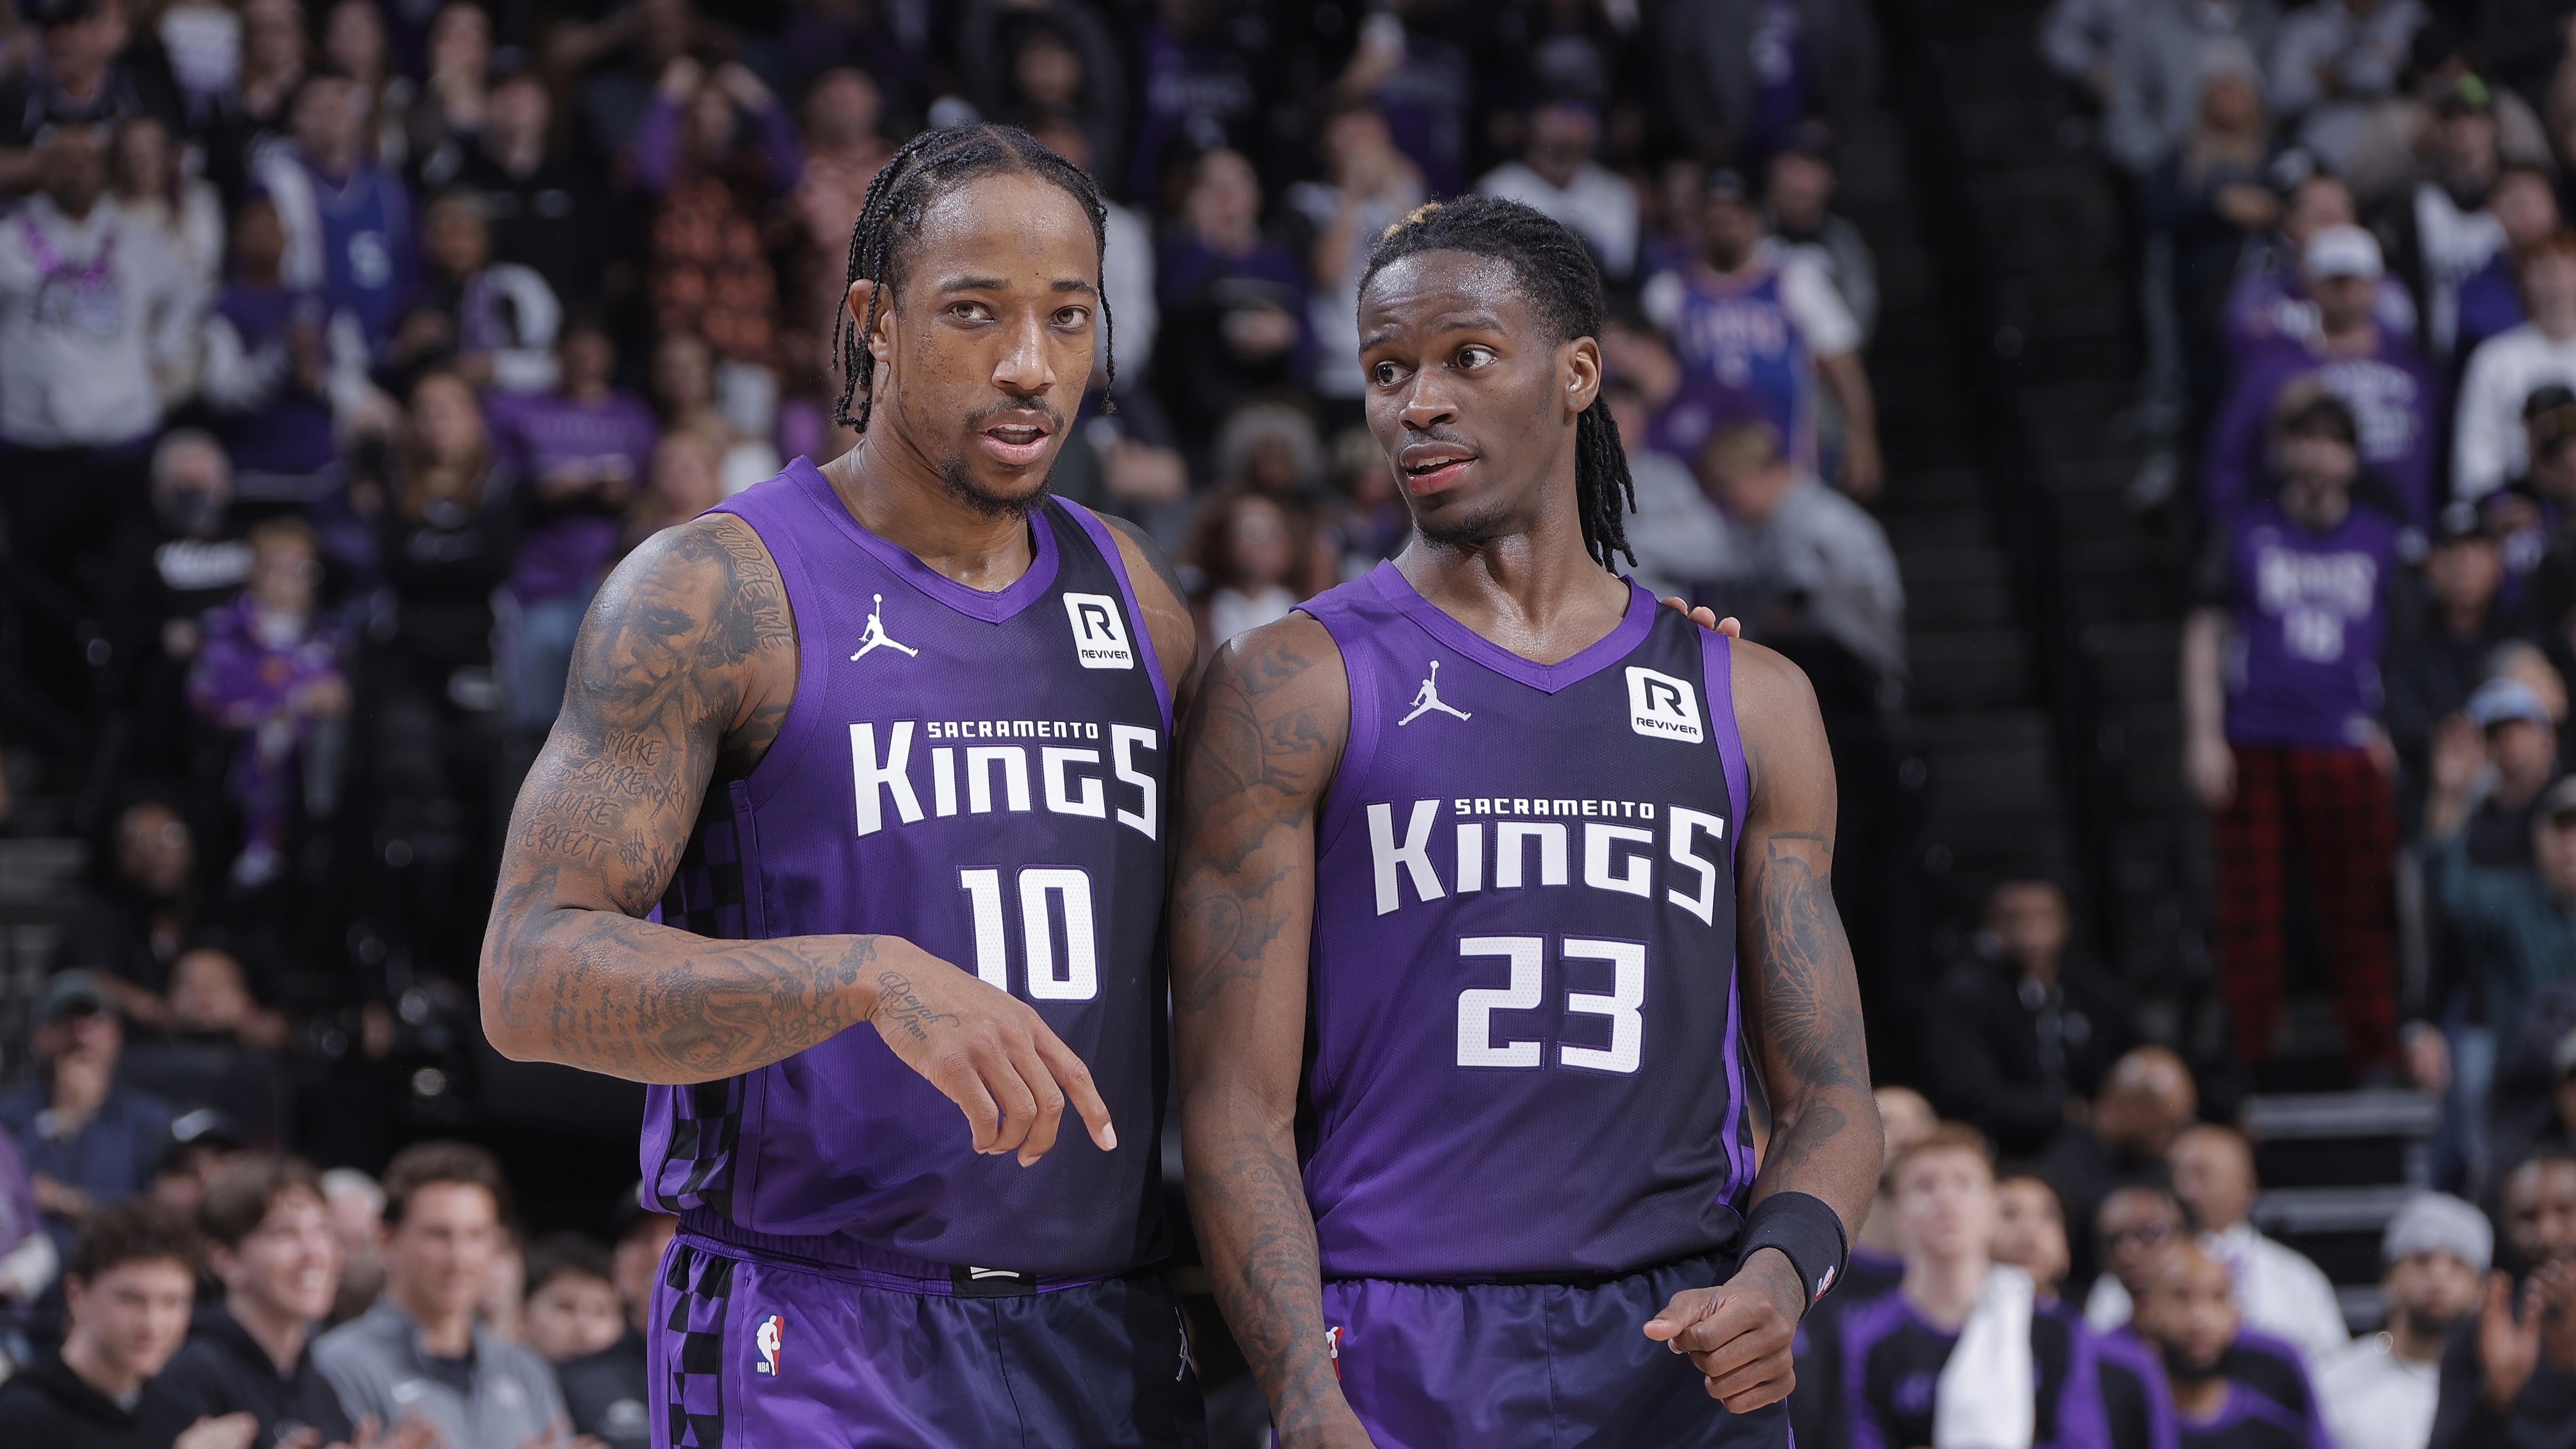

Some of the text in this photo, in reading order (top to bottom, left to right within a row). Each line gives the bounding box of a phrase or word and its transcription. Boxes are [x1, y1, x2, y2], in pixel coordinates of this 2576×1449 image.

[1077, 603, 1116, 640] R
[1081, 650, 1129, 659] REVIVER
[1643, 677, 1686, 717] R
[927, 721, 1098, 739] SACRAMENTO
[1636, 717, 1698, 735] REVIVER
[1455, 798, 1654, 819] SACRAMENTO
[960, 868, 1098, 1000] 10
[1457, 936, 1645, 1073] 23
[757, 1362, 770, 1373] NBA
